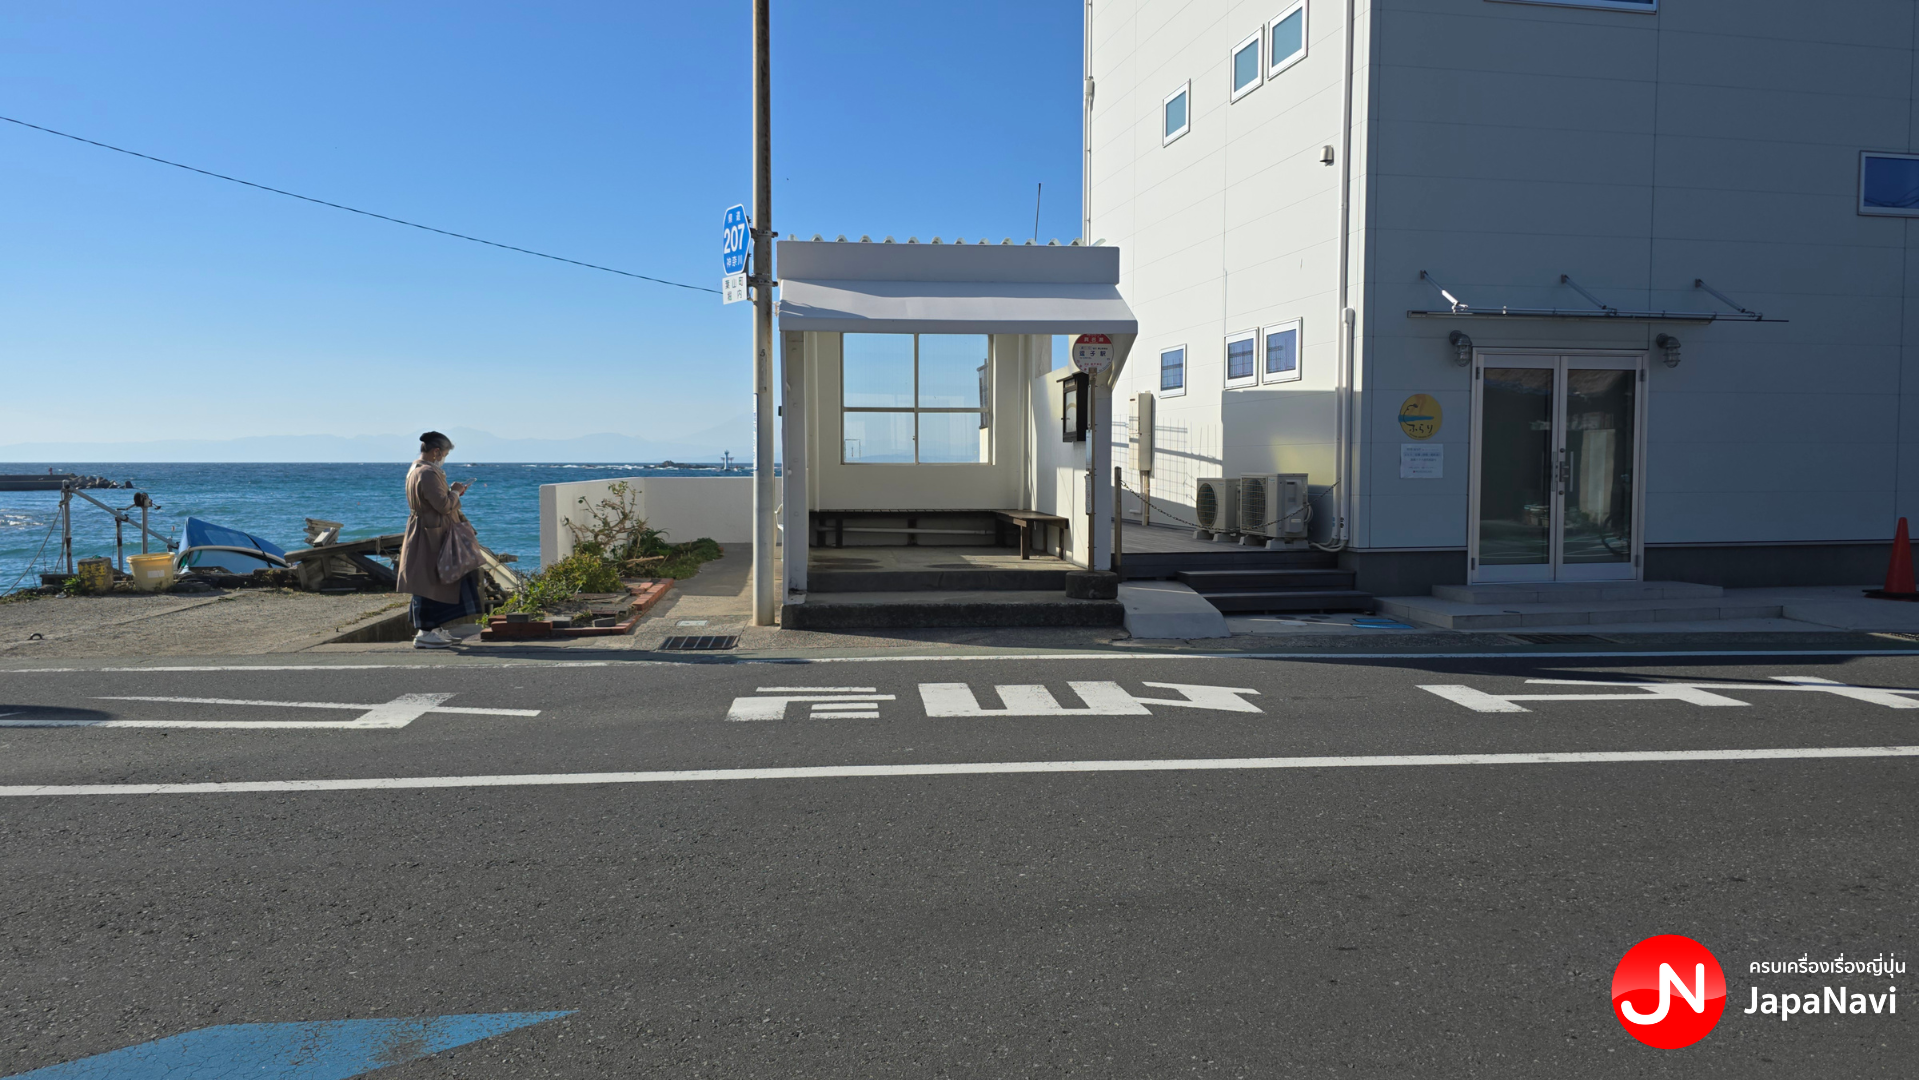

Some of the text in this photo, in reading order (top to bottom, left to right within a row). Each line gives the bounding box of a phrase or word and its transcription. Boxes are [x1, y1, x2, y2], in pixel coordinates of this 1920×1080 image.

[724, 223, 745, 254] 207
[1408, 423, 1434, 434] ふらり
